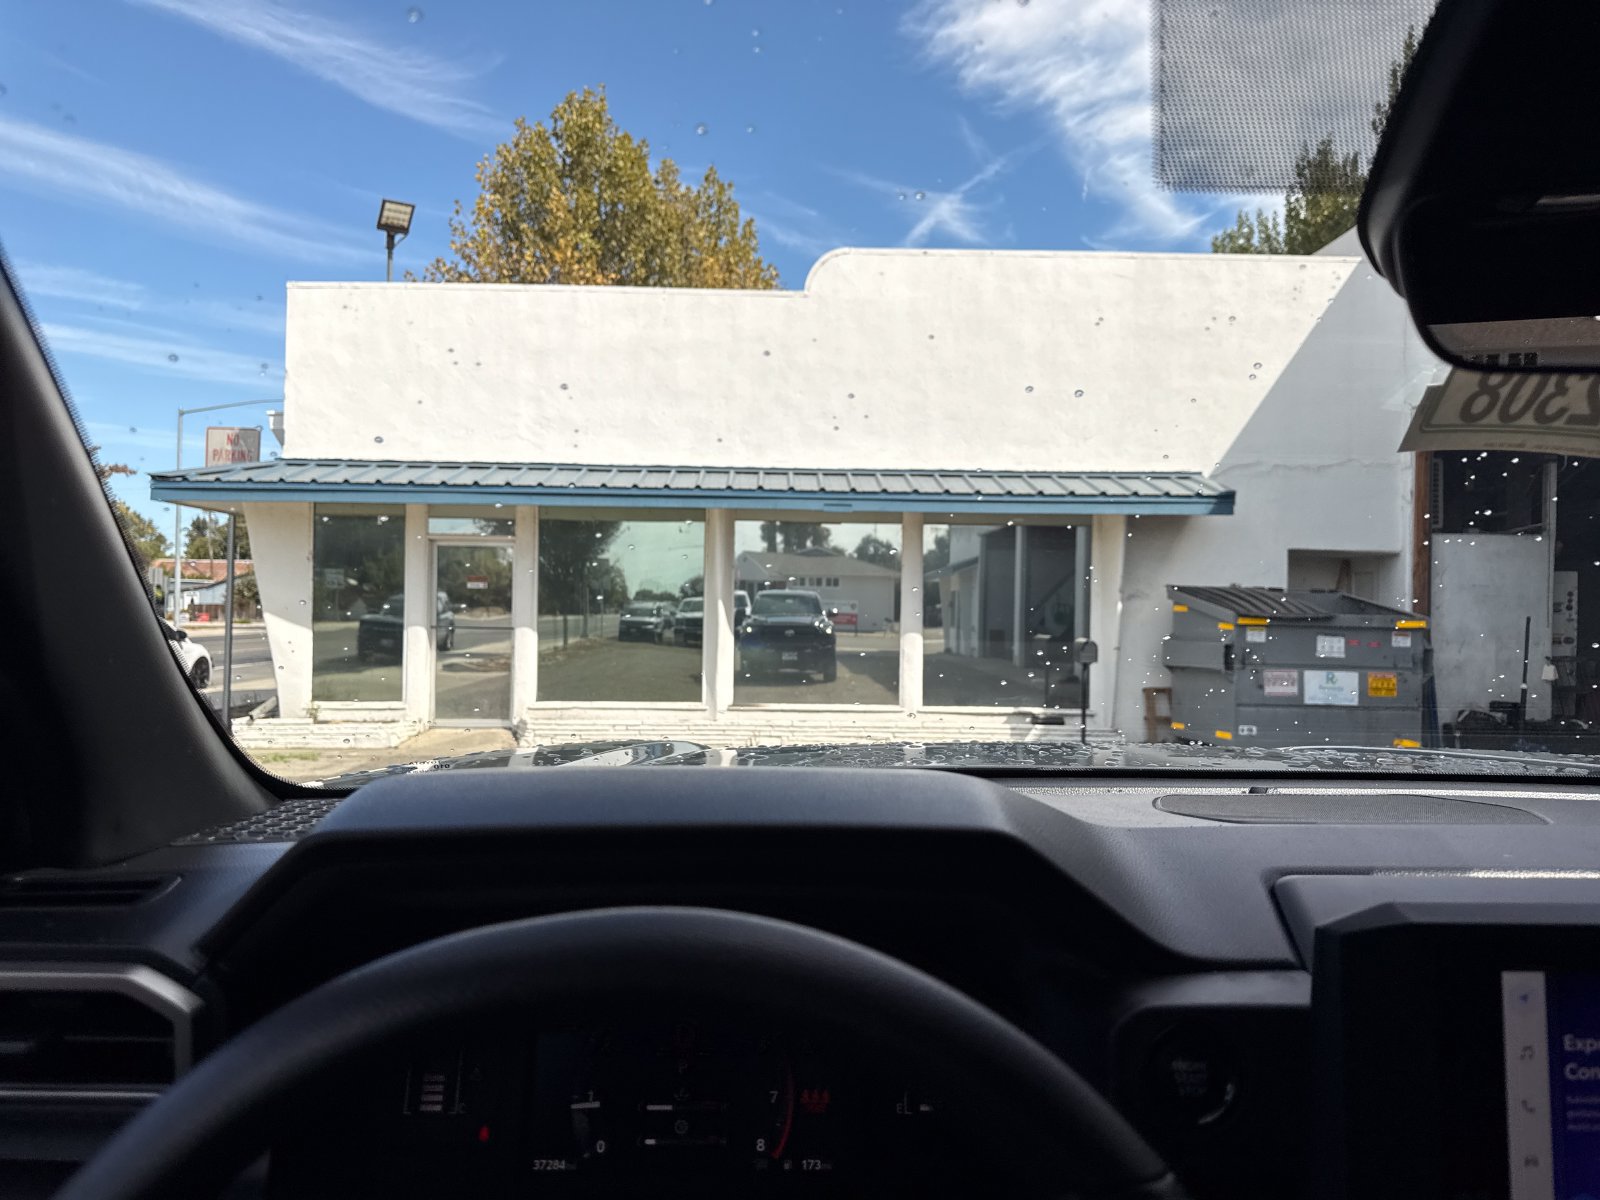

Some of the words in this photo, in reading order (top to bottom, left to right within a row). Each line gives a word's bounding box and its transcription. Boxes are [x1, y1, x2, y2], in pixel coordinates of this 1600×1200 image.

[226, 433, 240, 447] NO
[212, 449, 253, 463] PARKING
[1563, 1034, 1600, 1054] Exp
[768, 1090, 779, 1104] 7
[596, 1139, 606, 1154] 0
[755, 1138, 765, 1152] 8
[532, 1159, 566, 1171] 37284
[801, 1159, 822, 1171] 173
